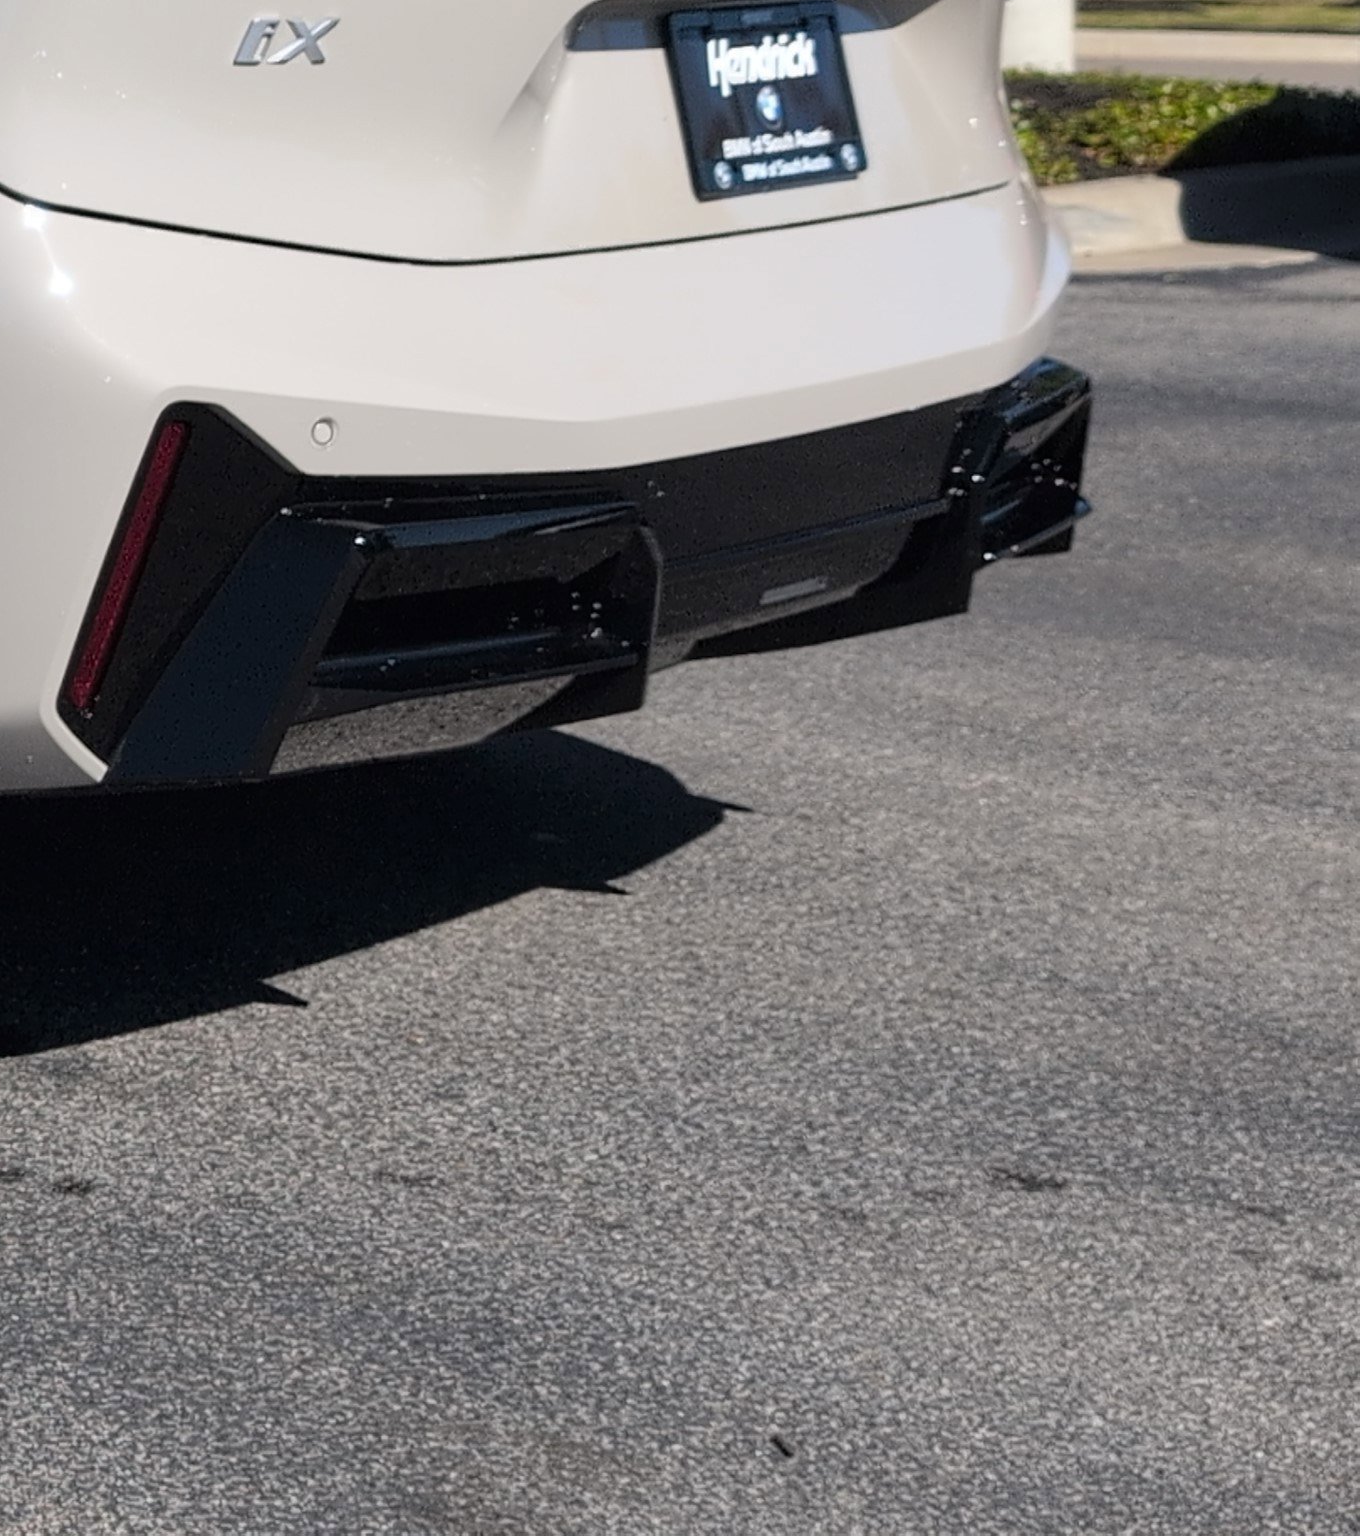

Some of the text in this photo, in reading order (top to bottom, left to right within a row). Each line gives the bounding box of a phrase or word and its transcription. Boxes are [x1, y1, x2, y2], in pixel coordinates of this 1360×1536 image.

[232, 15, 341, 66] iX
[707, 31, 818, 98] Hendrick
[722, 136, 752, 160] BMW
